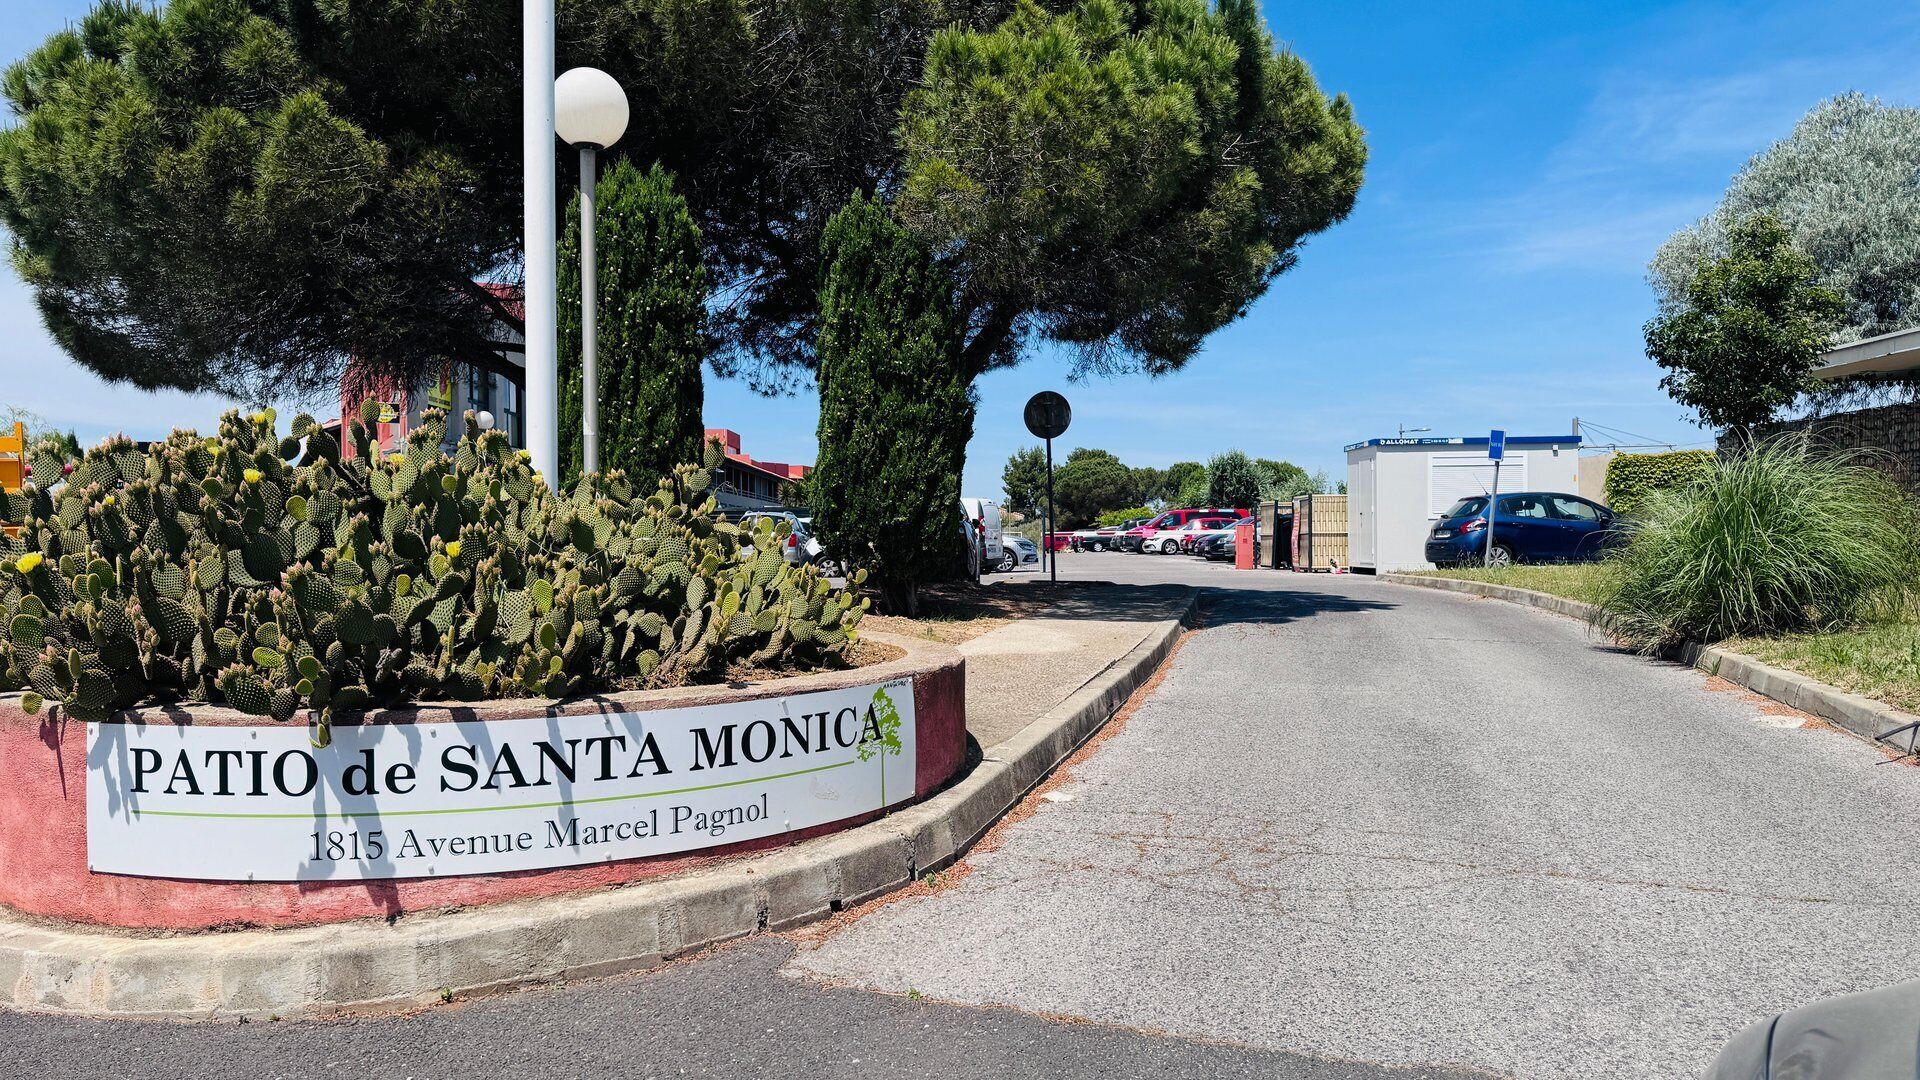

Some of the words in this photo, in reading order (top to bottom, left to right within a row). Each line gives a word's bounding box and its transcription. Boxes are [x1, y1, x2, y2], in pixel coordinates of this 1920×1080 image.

[129, 747, 319, 798] PATIO
[340, 748, 417, 796] de
[439, 731, 673, 793] SANTA
[689, 702, 884, 771] MONICA
[309, 829, 384, 861] 1815
[394, 828, 534, 859] Avenue
[543, 809, 659, 849] Marcel
[668, 792, 769, 838] Pagnol
